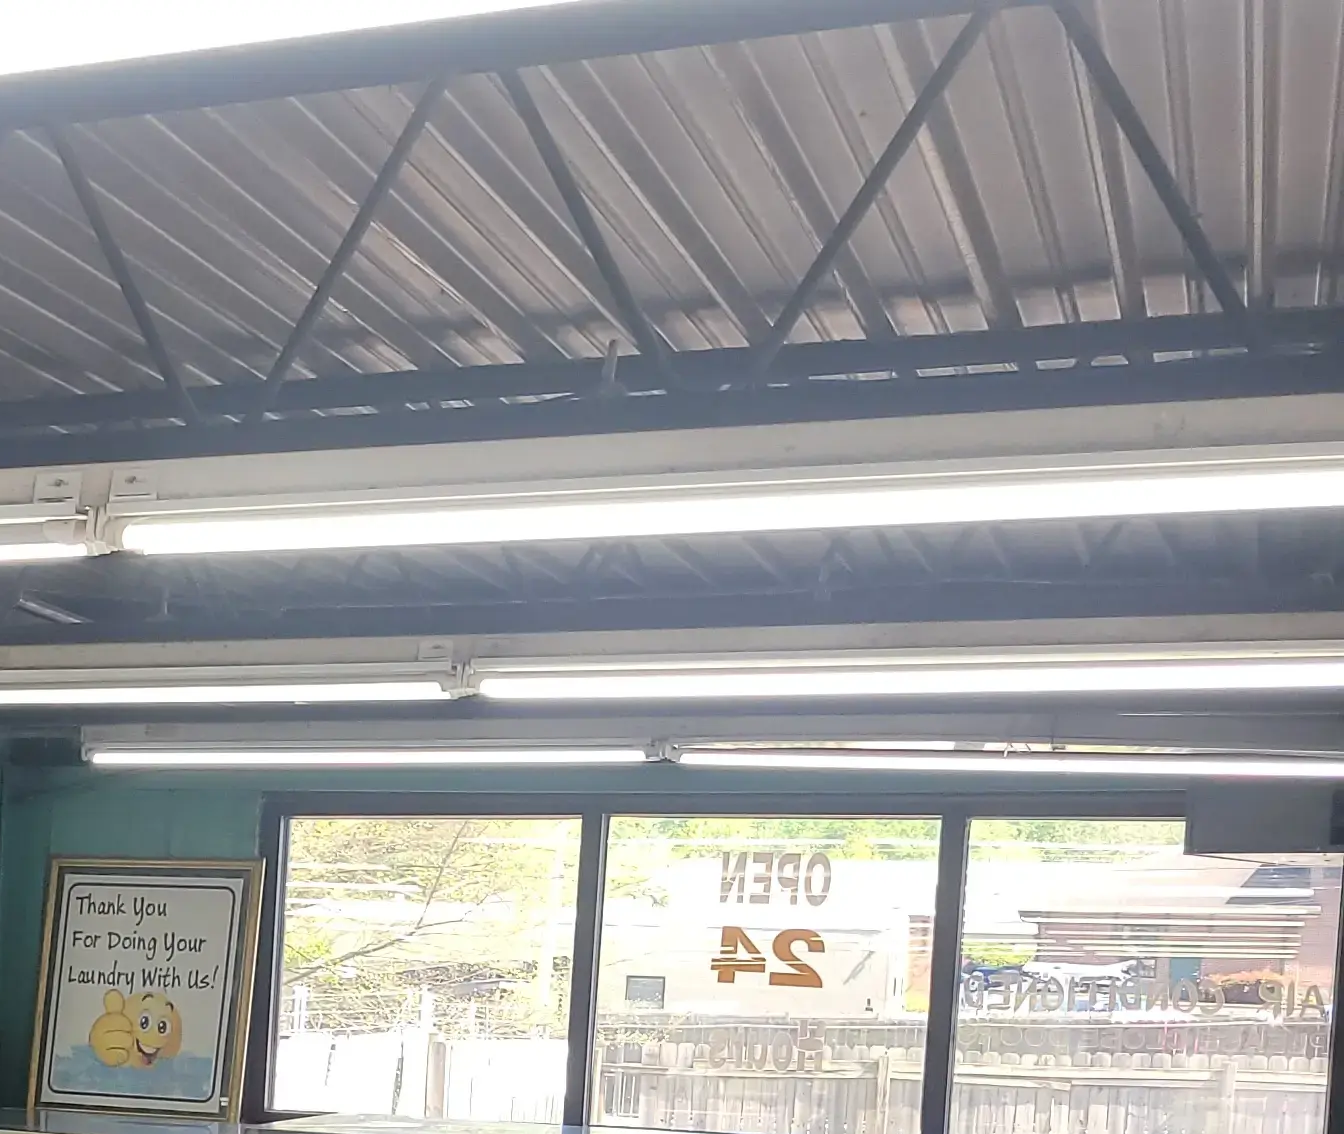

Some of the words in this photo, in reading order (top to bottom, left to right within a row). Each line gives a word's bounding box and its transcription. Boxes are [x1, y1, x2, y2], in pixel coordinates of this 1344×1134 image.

[76, 893, 127, 916] Thank
[133, 897, 167, 926] You
[72, 931, 101, 948] For
[107, 931, 157, 961] Doing
[164, 932, 207, 962] Your
[68, 960, 135, 994] Laundry
[141, 967, 181, 988] With
[187, 965, 219, 990] Us!
